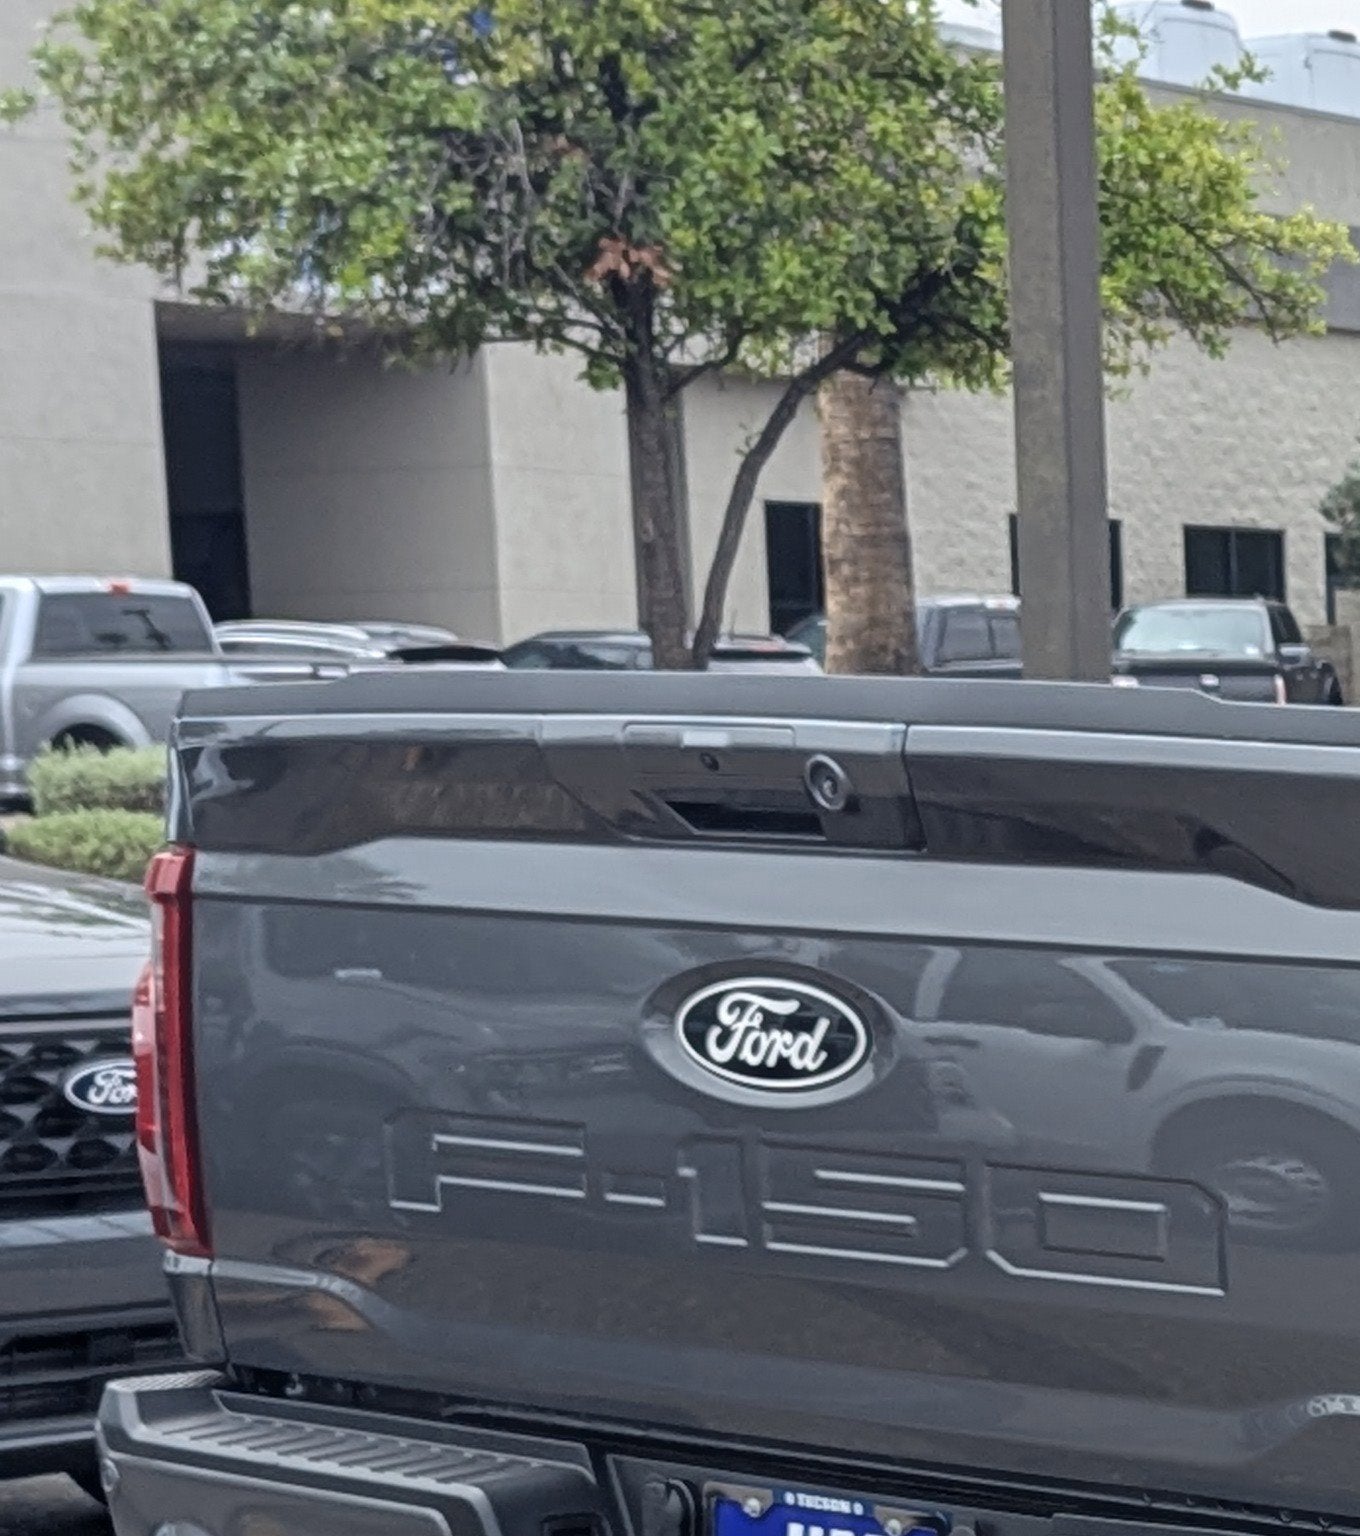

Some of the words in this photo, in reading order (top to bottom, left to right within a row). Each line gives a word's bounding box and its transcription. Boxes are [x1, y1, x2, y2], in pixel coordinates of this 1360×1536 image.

[705, 991, 831, 1071] Ford
[88, 1070, 138, 1104] For
[384, 1106, 1228, 1297] F-150
